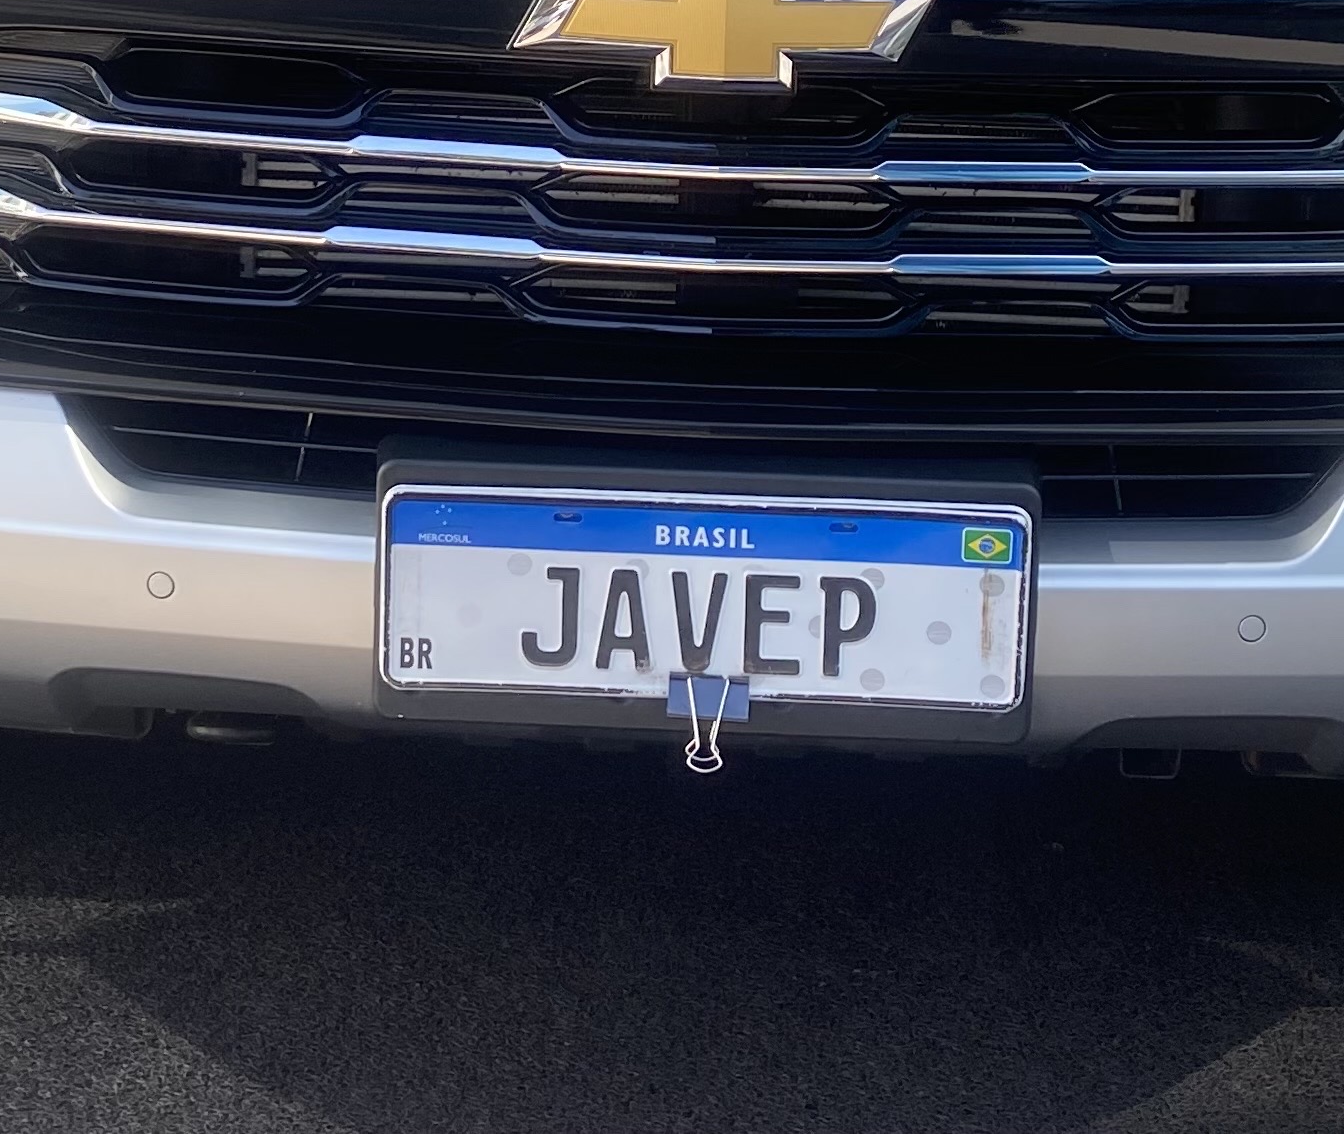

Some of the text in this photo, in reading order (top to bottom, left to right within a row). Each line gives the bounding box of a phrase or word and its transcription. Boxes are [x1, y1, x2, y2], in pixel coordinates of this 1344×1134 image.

[418, 533, 472, 544] MERCOSUL
[656, 525, 755, 549] BRASIL
[521, 567, 876, 676] JAVEP
[400, 637, 433, 669] BR
